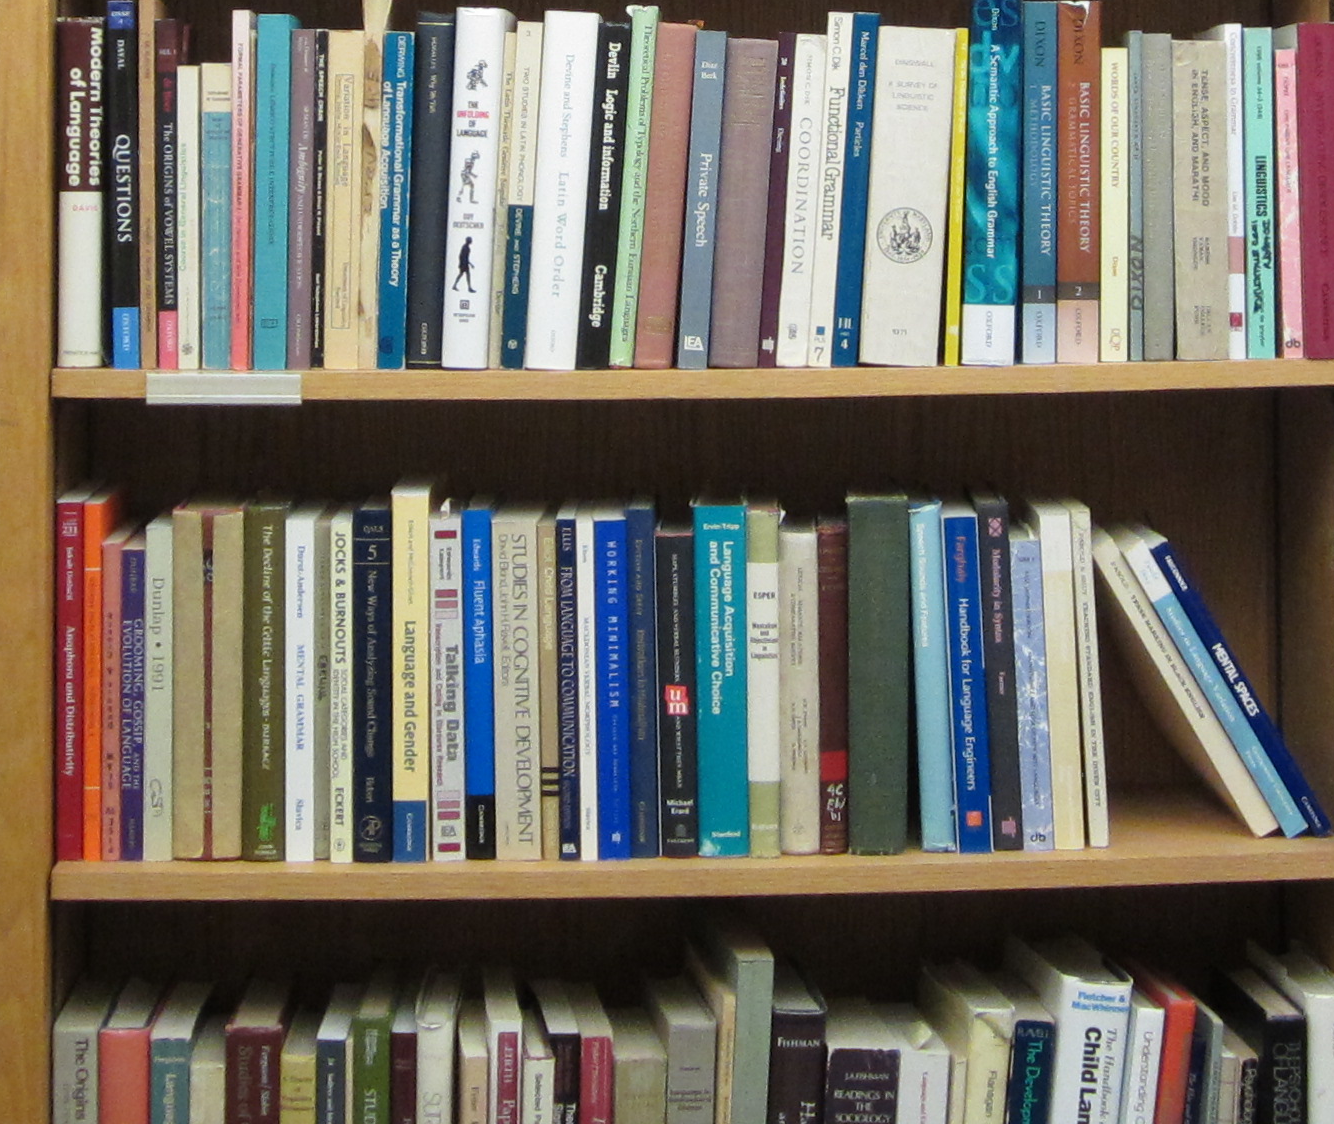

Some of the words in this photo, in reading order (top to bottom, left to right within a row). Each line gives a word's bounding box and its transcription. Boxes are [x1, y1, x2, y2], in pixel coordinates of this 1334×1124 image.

[68, 68, 86, 88] of
[88, 27, 104, 102] Modern
[116, 39, 126, 69] DAYAL
[606, 42, 621, 79] Devlin
[602, 89, 618, 119] Logic
[825, 86, 846, 165] Functional
[1079, 82, 1090, 117] BASIC
[65, 92, 85, 186] Language
[88, 106, 104, 186] Theories
[603, 122, 616, 142] and
[598, 145, 615, 210] information
[697, 153, 713, 198] Private
[1079, 122, 1090, 197] LINGUISTIC
[112, 134, 132, 243] QUESTIONS
[820, 167, 840, 240] Grammar
[693, 201, 711, 247] Speech
[1079, 201, 1090, 253] THEORY
[590, 265, 608, 328] Cambridge
[334, 532, 347, 575] JOCKS
[335, 578, 346, 589] &
[473, 580, 487, 616] Fluent
[334, 592, 347, 664] BURNOUTS
[472, 619, 487, 664] Aphasia
[958, 598, 974, 656] Handbook
[401, 620, 418, 689] Language
[443, 644, 460, 713] Talking
[960, 659, 974, 676] for
[1212, 642, 1239, 682] MENTAL
[1230, 681, 1260, 718] SPACES
[404, 691, 418, 718] and
[958, 679, 977, 733] Language
[403, 721, 418, 772] Gender
[445, 719, 460, 762] Data
[962, 736, 978, 791] Engineers
[334, 787, 345, 826] ECKERT
[74, 1038, 90, 1065] The
[1079, 1027, 1103, 1084] Child
[71, 1068, 88, 1120] Origins
